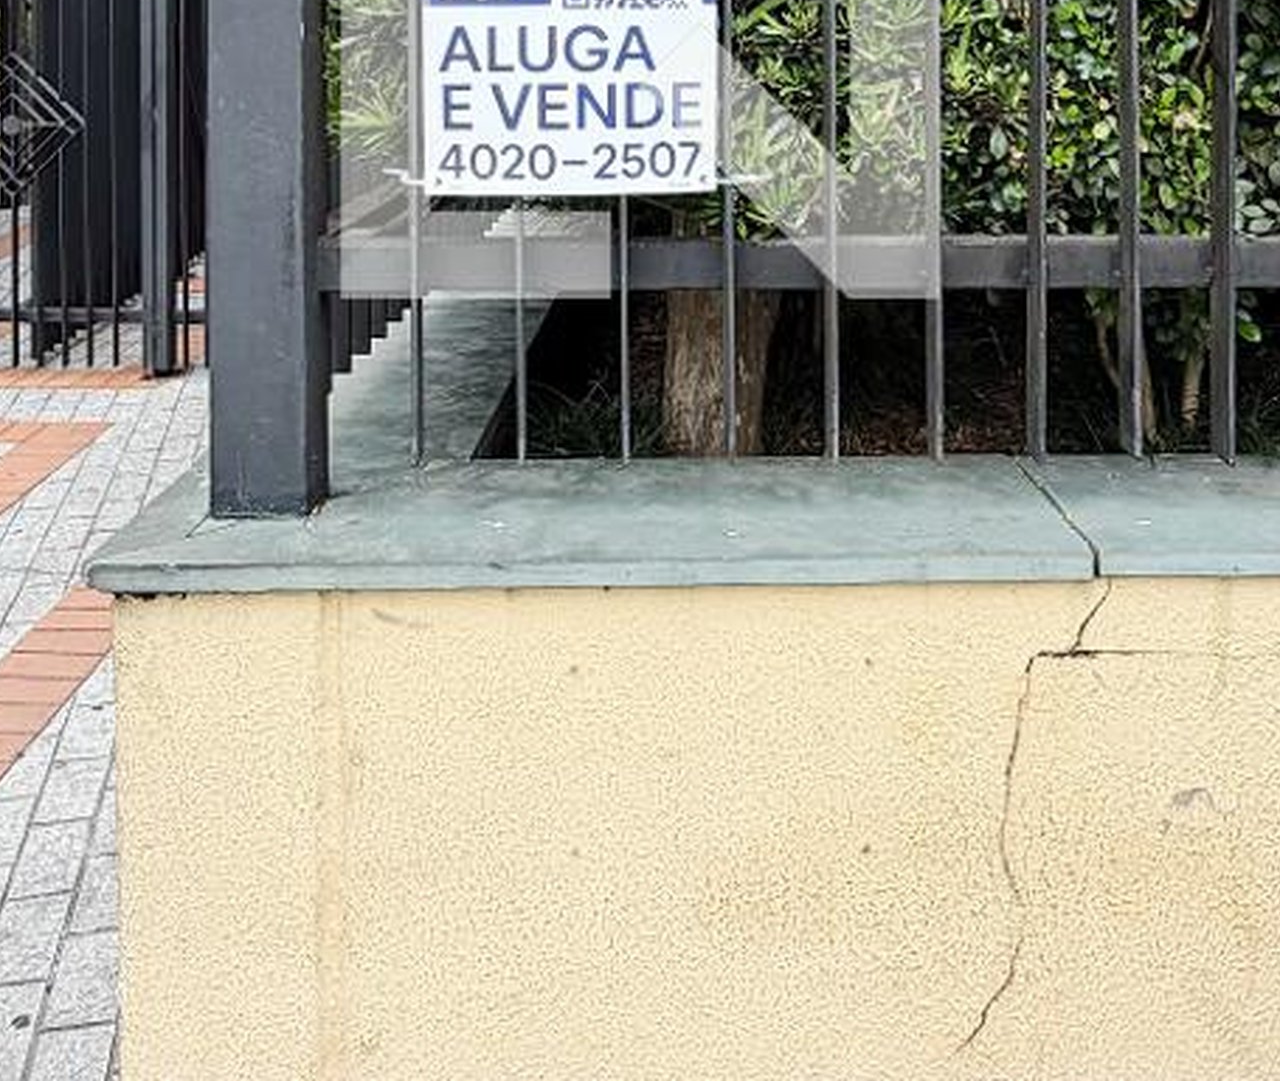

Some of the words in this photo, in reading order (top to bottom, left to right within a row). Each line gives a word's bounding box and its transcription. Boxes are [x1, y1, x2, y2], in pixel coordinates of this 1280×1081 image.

[439, 24, 656, 72] ALUGA
[442, 83, 473, 130] E
[491, 82, 702, 131] VENDE
[439, 141, 702, 181] 4020-2507
